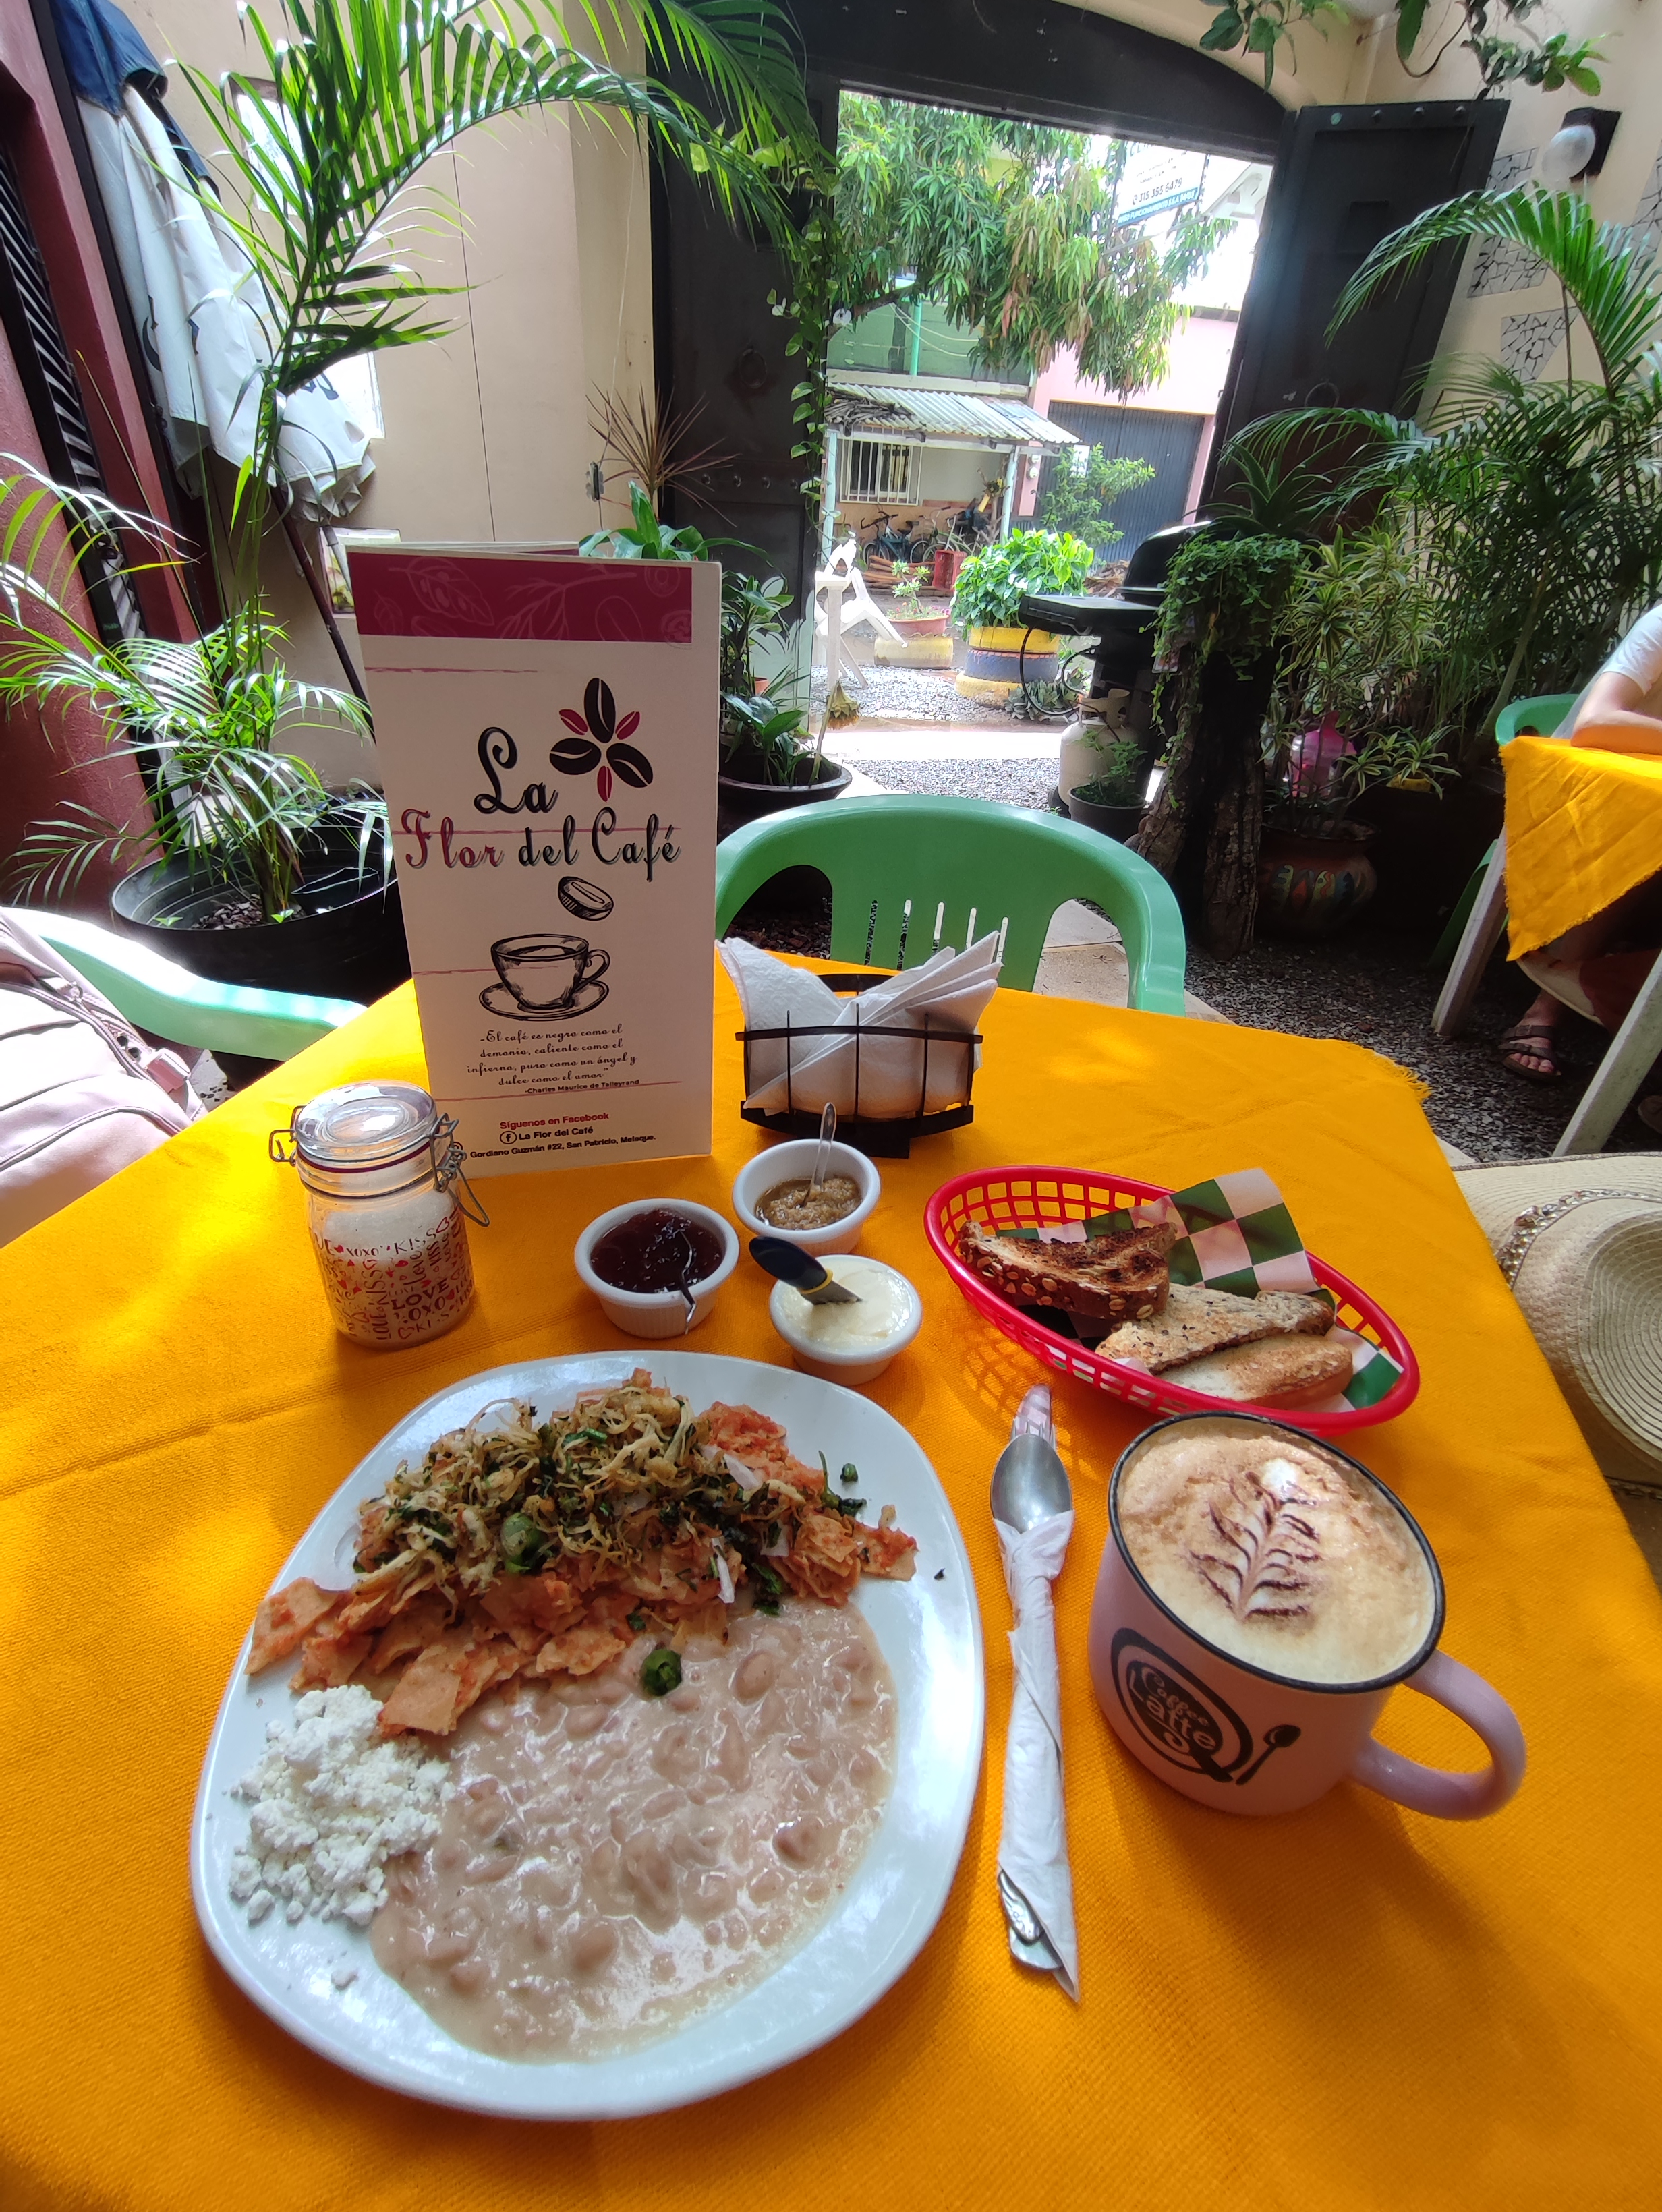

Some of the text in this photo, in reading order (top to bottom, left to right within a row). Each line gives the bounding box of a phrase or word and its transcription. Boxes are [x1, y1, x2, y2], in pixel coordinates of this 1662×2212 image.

[1151, 185, 1164, 198] 355
[473, 726, 558, 814] La
[401, 807, 681, 883] Flor del Café
[505, 1030, 529, 1044] café
[546, 1032, 578, 1042] negro
[611, 1023, 623, 1034] el
[480, 1038, 623, 1058] demonio, caliente como el
[467, 1062, 517, 1076] infierno,
[520, 1063, 548, 1074] puro
[597, 1052, 628, 1068] ángel
[629, 1056, 638, 1066] y
[498, 1075, 529, 1086] dulce
[531, 1076, 560, 1084] como
[562, 1070, 573, 1081] el
[525, 1086, 556, 1094] -Charles
[601, 1079, 639, 1088] Talleyrand
[500, 1119, 546, 1130] Síguenos
[563, 1112, 609, 1124] Facebook
[519, 1133, 531, 1141] La
[534, 1130, 552, 1139] Flor
[554, 1128, 569, 1138] del
[571, 1126, 594, 1136] Café
[470, 1134, 656, 1159] Gordiano Guzmán #22, San Patricio, Melaque.
[391, 1277, 449, 1310] LOVE
[1141, 1666, 1209, 1727] Coffee
[1129, 1668, 1217, 1754] Latte
